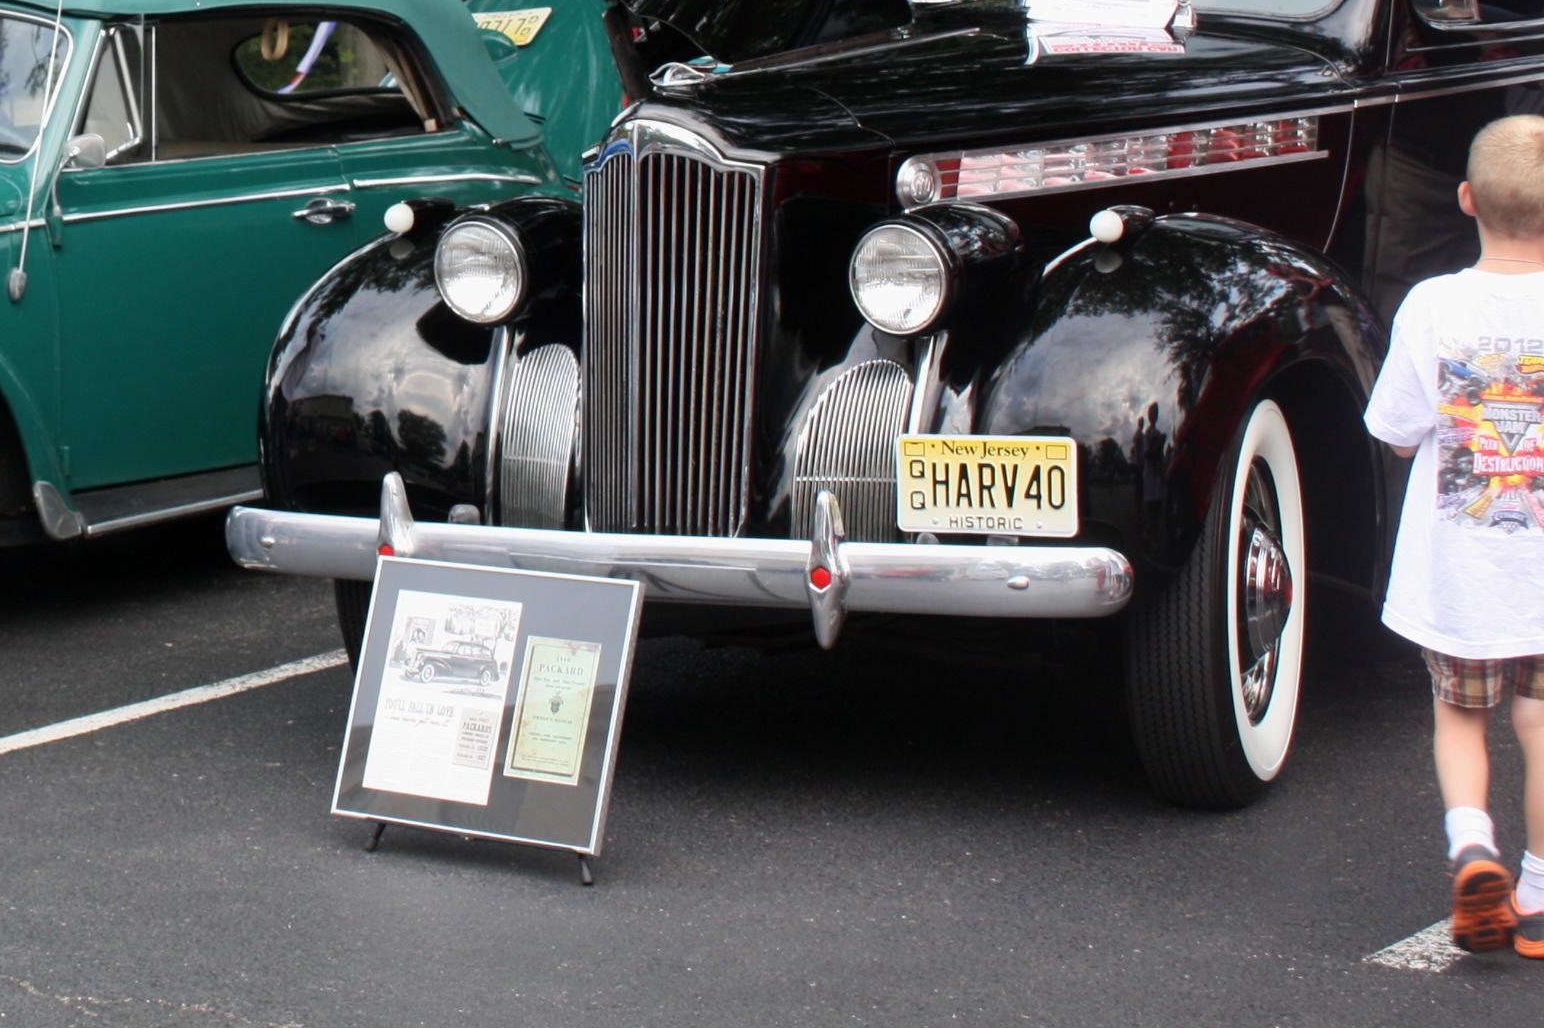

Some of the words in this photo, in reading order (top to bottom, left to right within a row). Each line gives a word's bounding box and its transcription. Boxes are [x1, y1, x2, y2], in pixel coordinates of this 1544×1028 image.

[1477, 336, 1544, 355] 2012
[941, 441, 977, 456] New
[981, 442, 1029, 460] Jersey
[949, 516, 1023, 530] HISTORIC
[539, 663, 584, 676] PACKARD
[437, 705, 455, 718] LOVE
